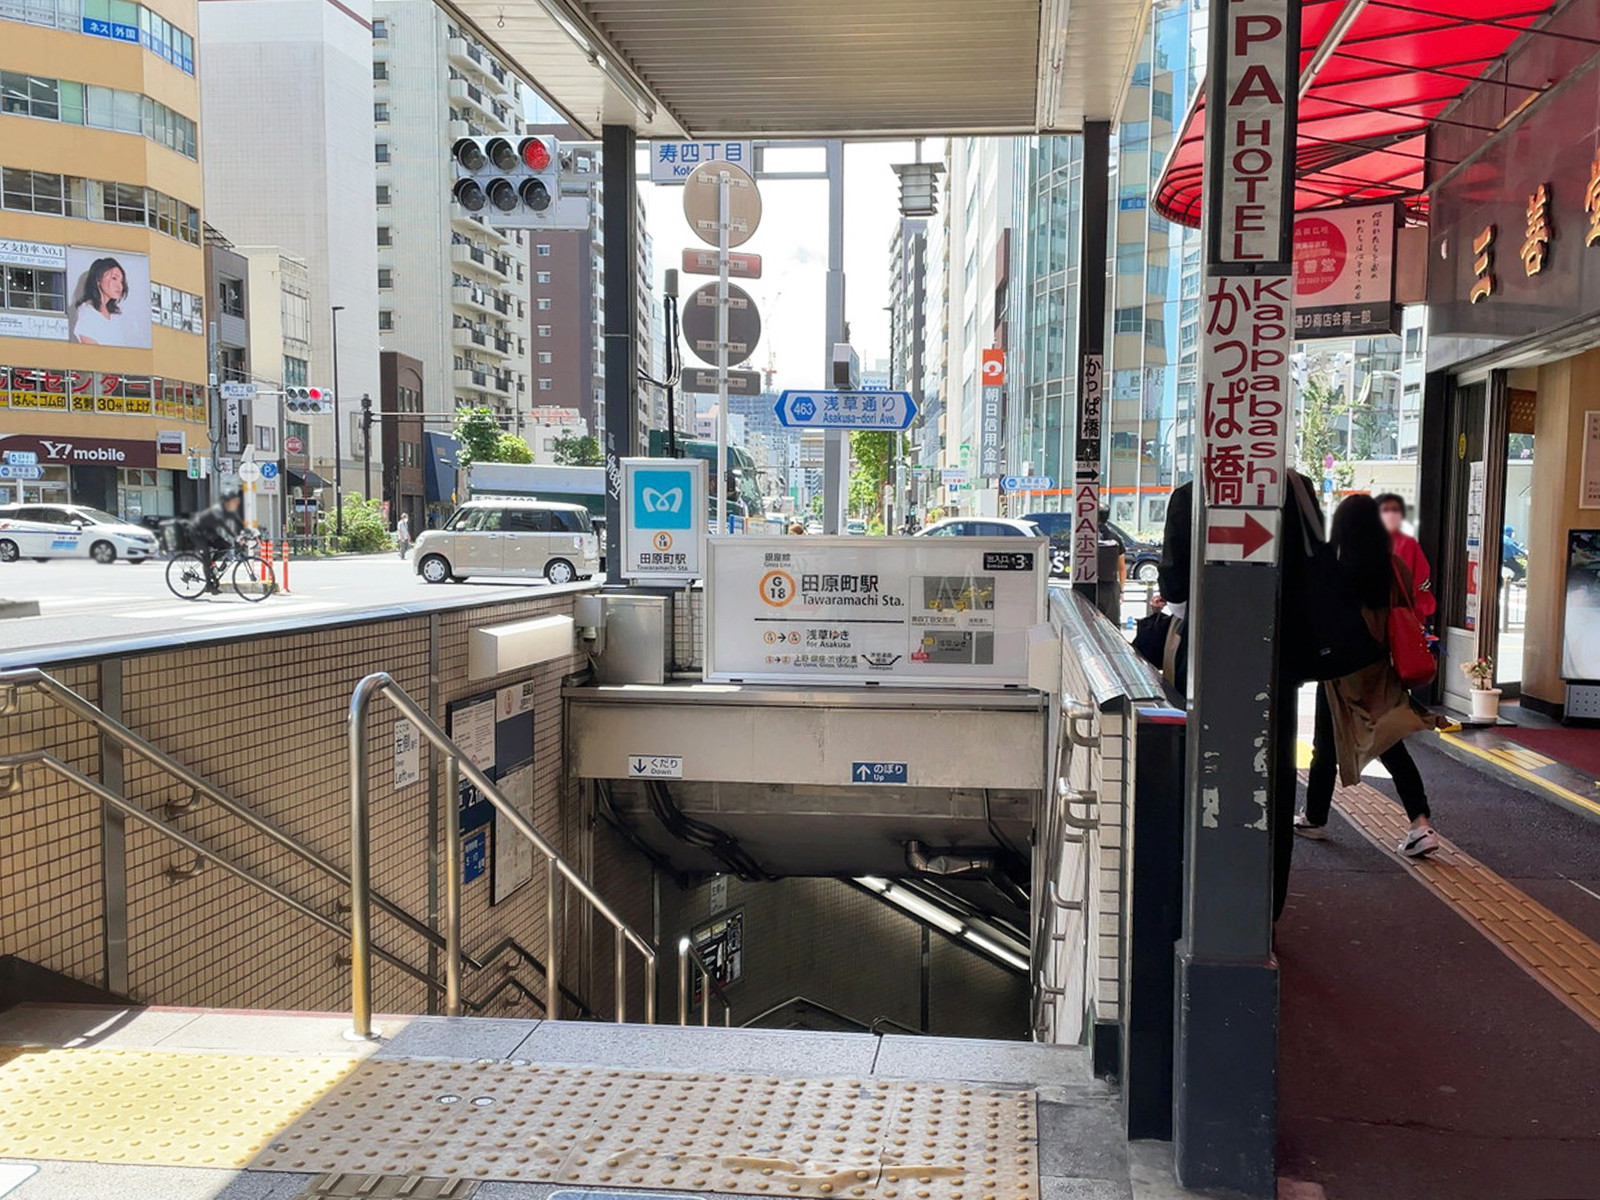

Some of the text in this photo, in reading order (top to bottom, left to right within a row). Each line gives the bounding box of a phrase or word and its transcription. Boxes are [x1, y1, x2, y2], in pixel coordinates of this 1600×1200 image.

[1228, 0, 1284, 106] PA
[659, 143, 742, 163] 寿四丁目
[1232, 120, 1273, 260] HOTEL
[1247, 278, 1289, 505] Kappabashi
[794, 403, 813, 415] 463
[823, 396, 896, 412] 浅草通り
[823, 413, 898, 424] Asakusa-dori Ave.
[983, 387, 999, 476] 朝日信用金庫
[640, 553, 687, 565] 田原町駅
[1015, 554, 1026, 569] 3
[772, 576, 784, 588] G
[801, 574, 879, 593] 田原町駅
[770, 587, 786, 600] 18
[801, 593, 905, 608] Tawaramachi Sta.
[806, 628, 849, 640] 浅草ゆき
[806, 640, 851, 649] for Asakusa
[651, 757, 678, 769] くだり
[651, 768, 672, 776] Down
[873, 764, 904, 775] のぼり
[873, 774, 885, 782] Up
